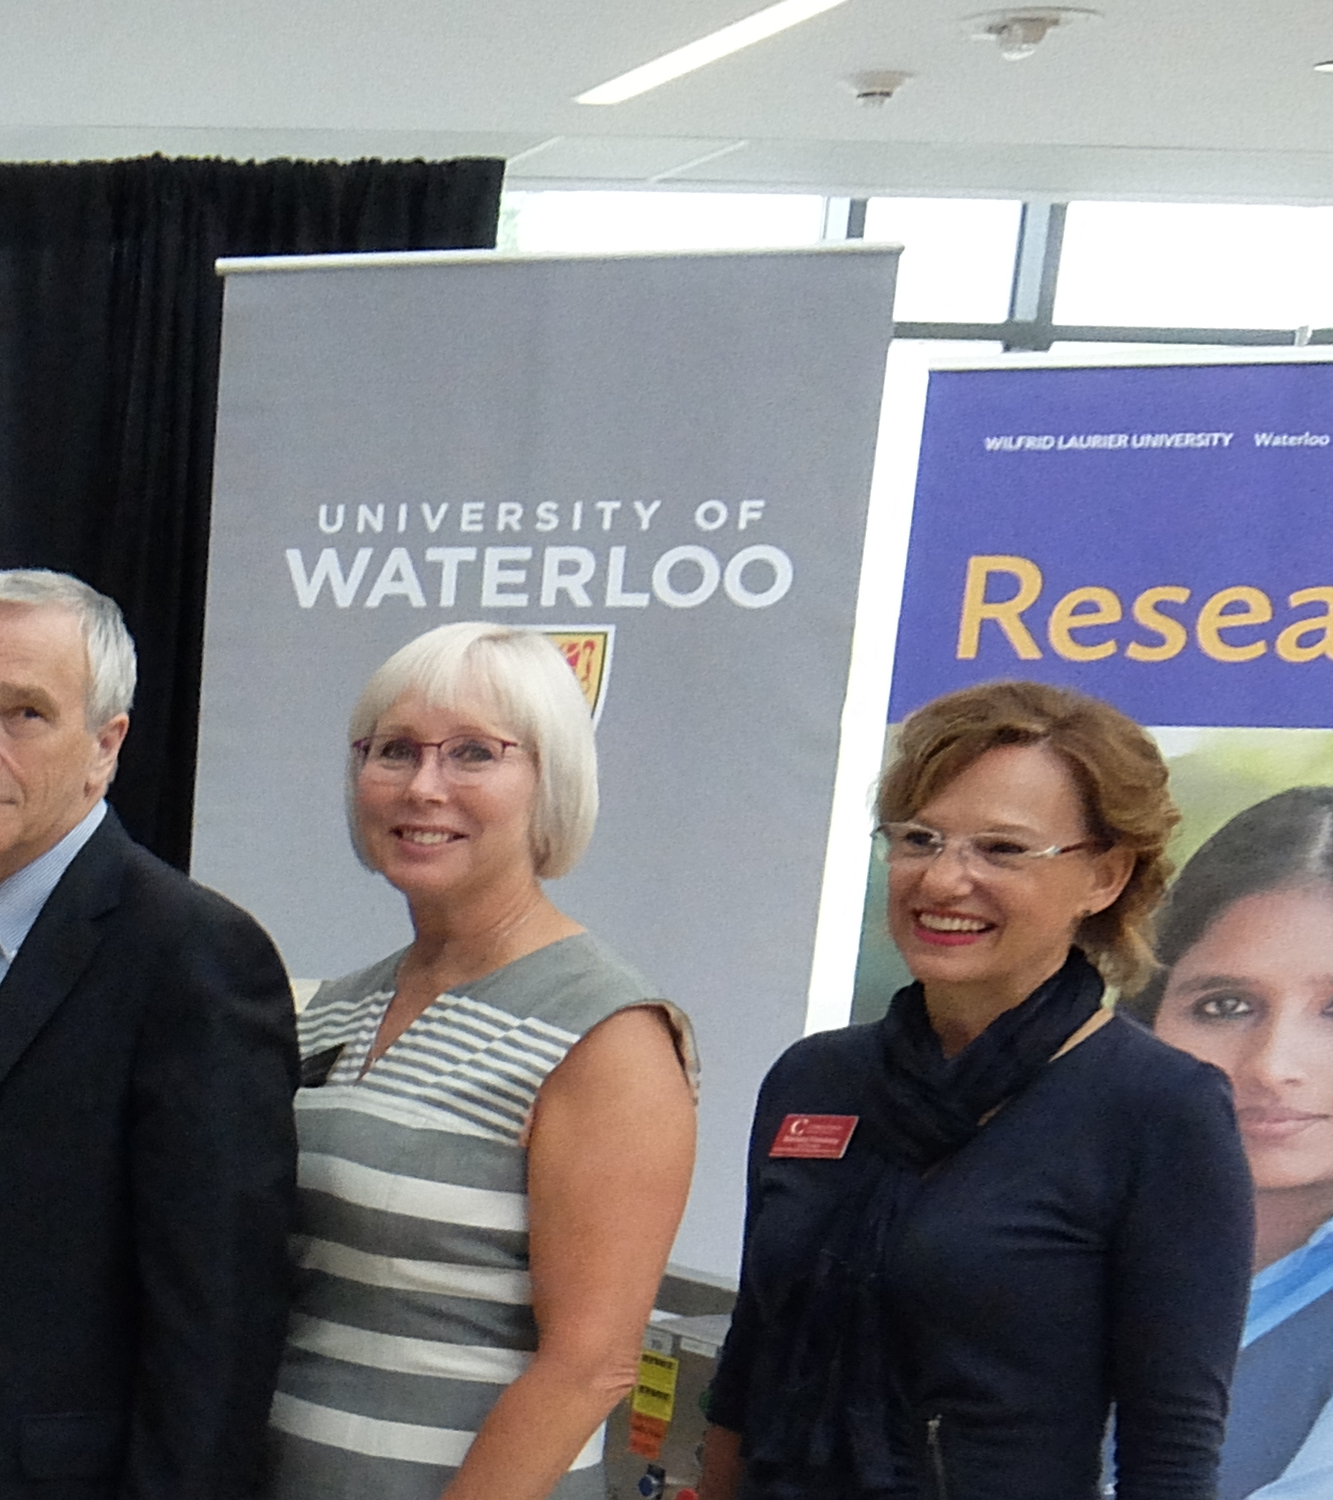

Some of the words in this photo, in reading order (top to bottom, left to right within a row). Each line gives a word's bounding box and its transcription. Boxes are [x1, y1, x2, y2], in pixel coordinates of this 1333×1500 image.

[984, 435, 1055, 451] WILFRID
[1057, 433, 1130, 450] LAURIER
[1132, 431, 1234, 448] UNIVERSITY
[1254, 430, 1330, 447] Waterloo
[318, 500, 661, 534] UNIVERSITY
[694, 499, 766, 530] OF
[285, 544, 794, 609] WATERLOO
[955, 554, 1333, 663] Resea
